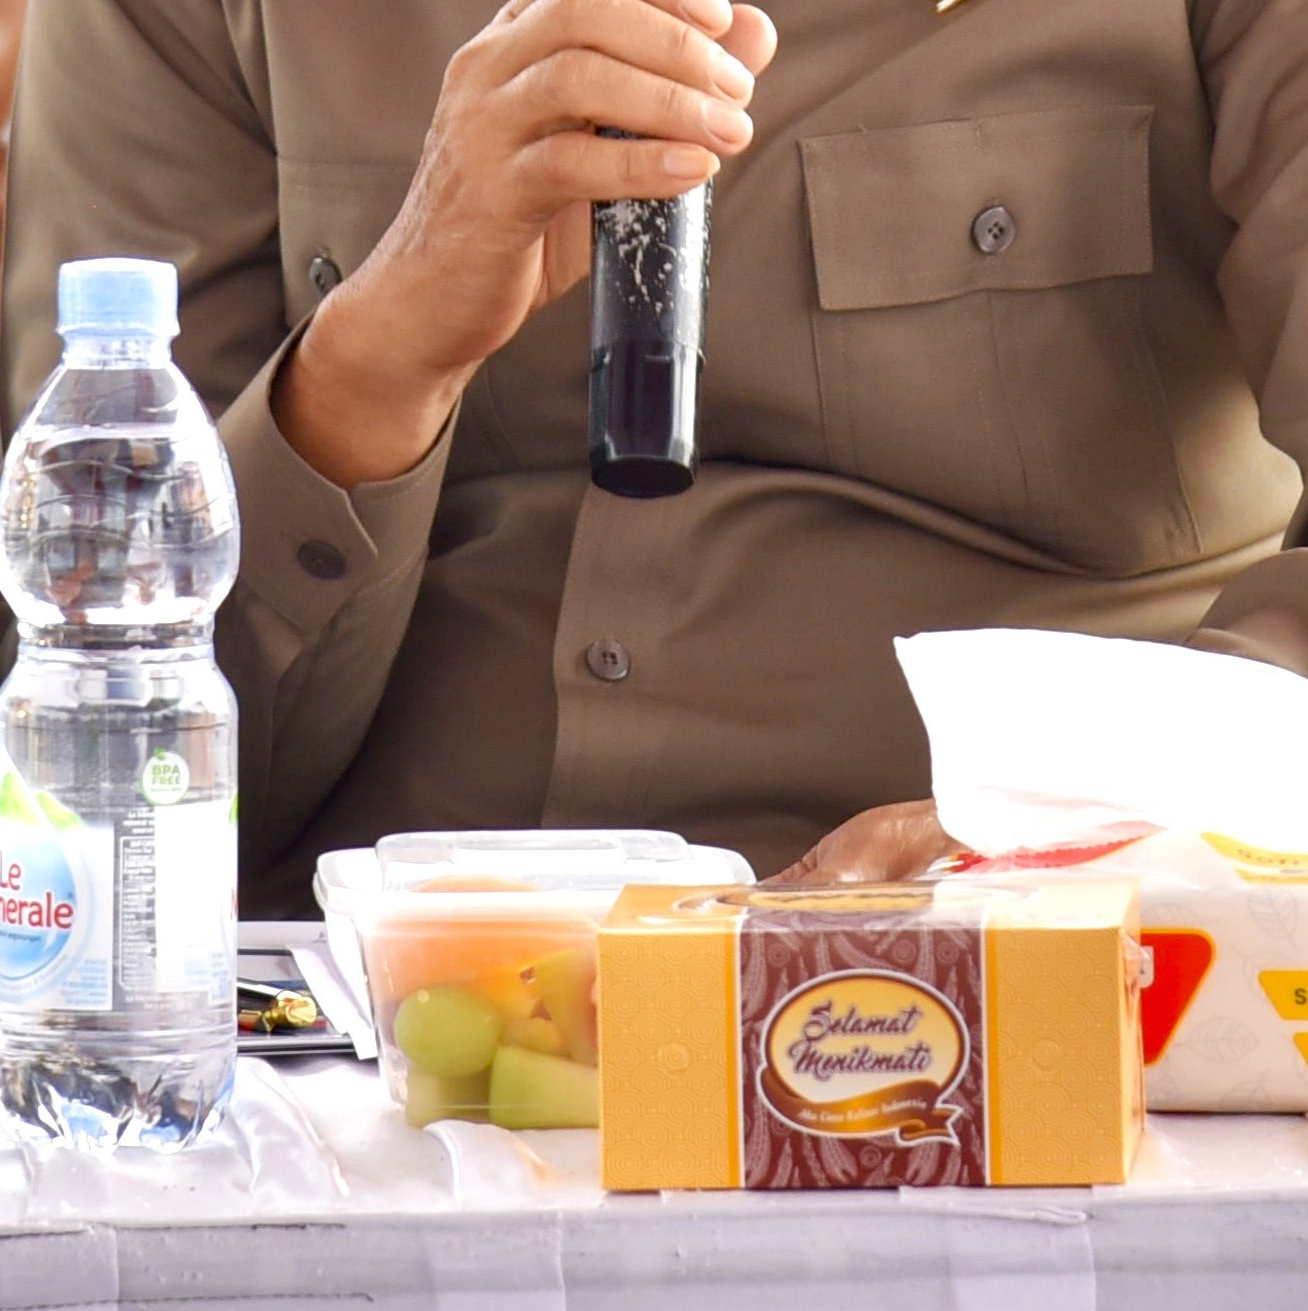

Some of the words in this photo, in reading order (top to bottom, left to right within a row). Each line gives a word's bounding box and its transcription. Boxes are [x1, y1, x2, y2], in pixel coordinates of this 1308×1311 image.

[152, 764, 181, 776] BPA
[152, 776, 181, 786] FREE
[802, 999, 922, 1042] Selamat
[788, 1041, 933, 1082] Menikmati
